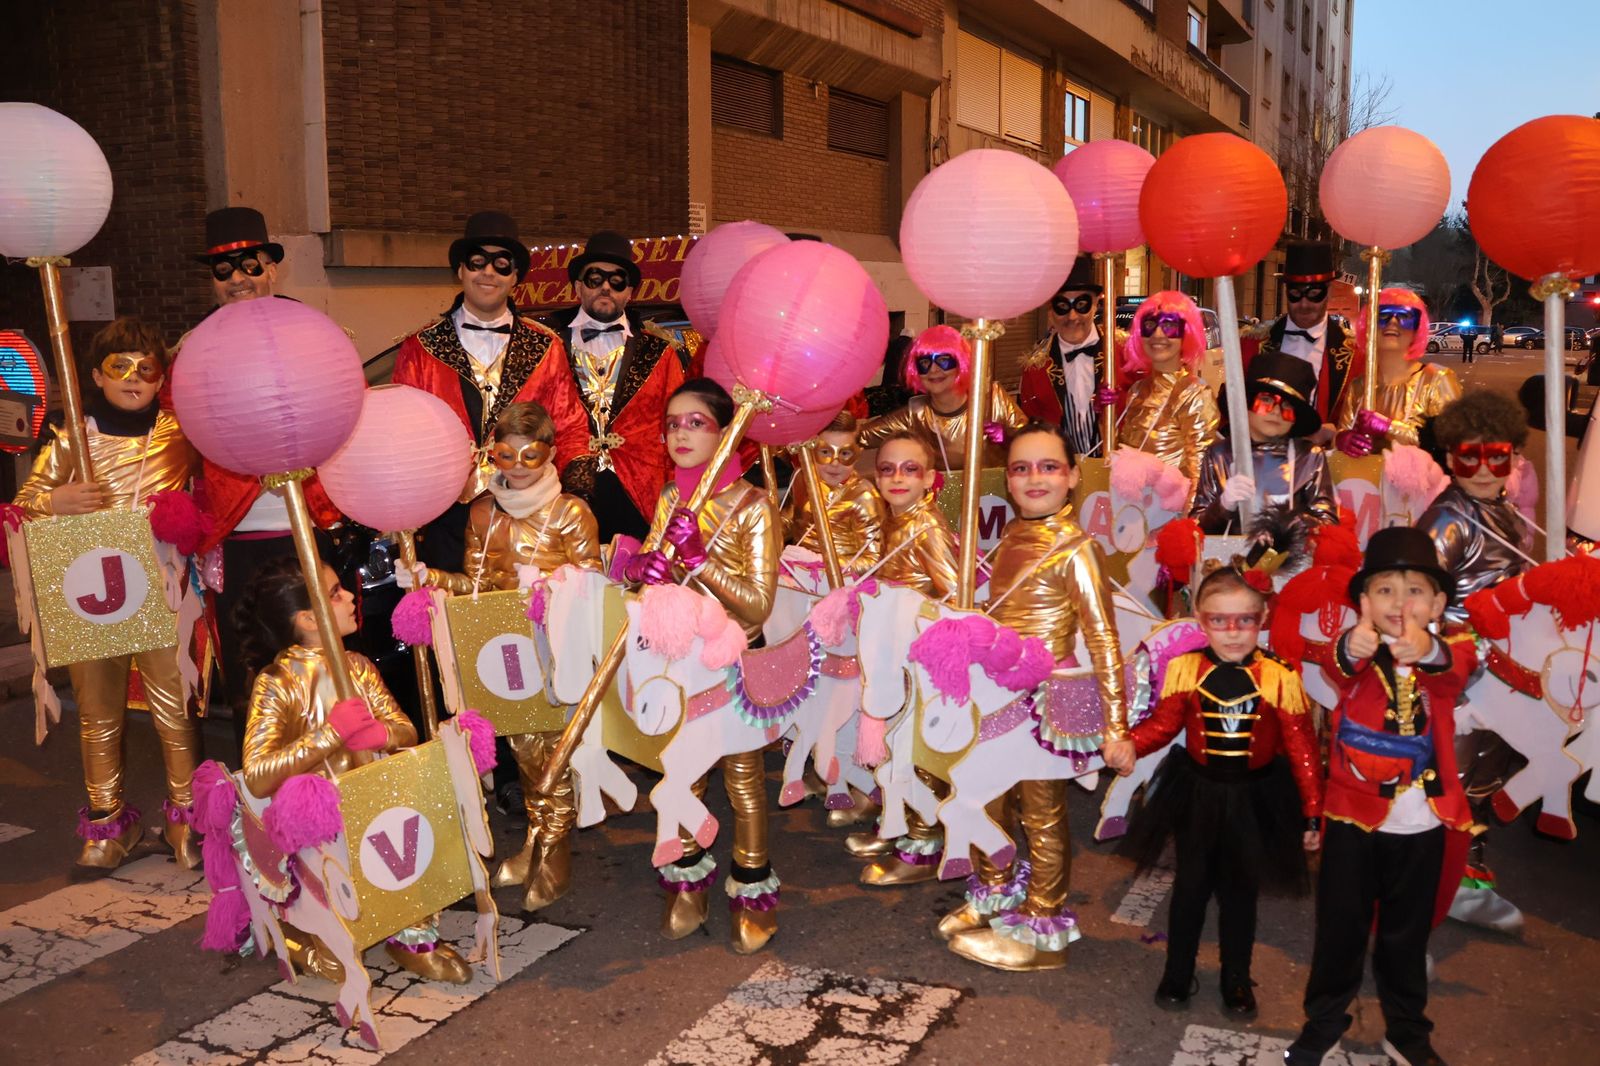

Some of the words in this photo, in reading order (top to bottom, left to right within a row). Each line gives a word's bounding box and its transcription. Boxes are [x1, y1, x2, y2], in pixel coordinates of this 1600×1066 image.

[510, 277, 681, 305] ENCADO
[978, 505, 1007, 541] M
[1086, 495, 1116, 548] A
[76, 554, 127, 616] J
[501, 643, 525, 692] I
[366, 814, 420, 882] V
